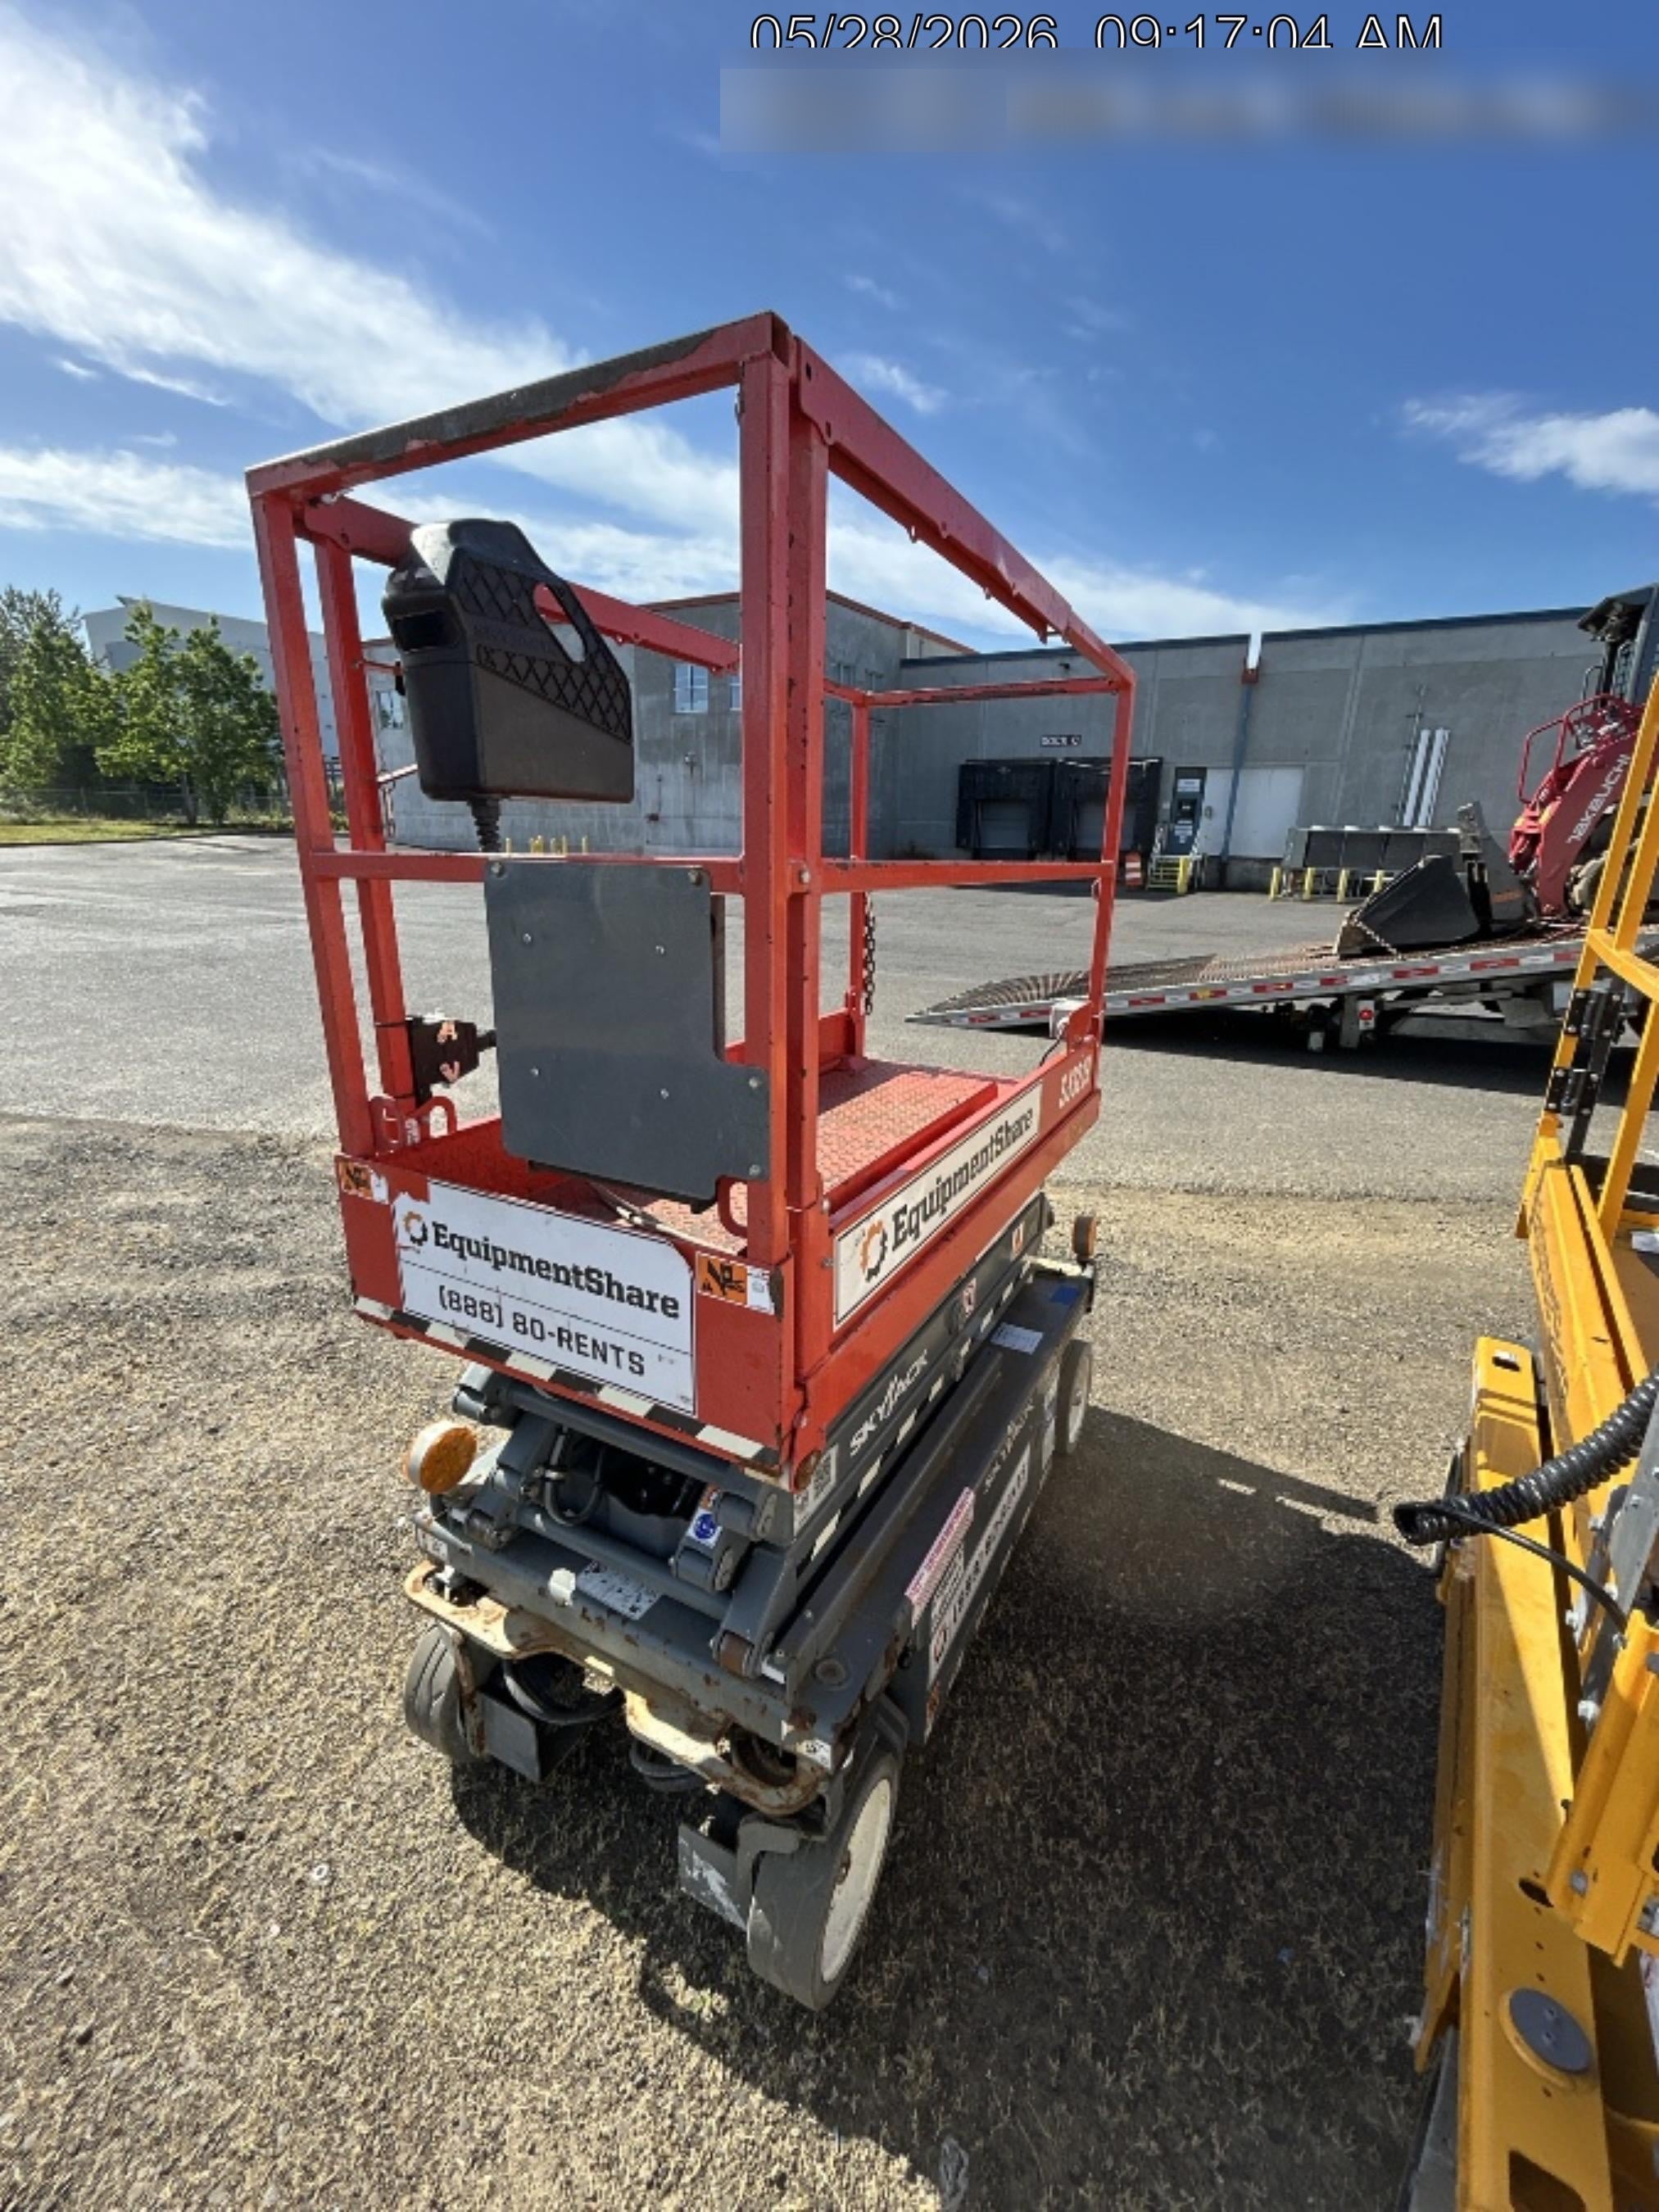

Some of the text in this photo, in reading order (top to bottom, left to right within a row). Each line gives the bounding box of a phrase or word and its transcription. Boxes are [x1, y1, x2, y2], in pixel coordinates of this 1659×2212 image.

[891, 1107, 1035, 1252] EquipmentShare
[432, 1220, 680, 1320] EquipmentShare
[439, 1285, 646, 1377] (888) 80-RENTS
